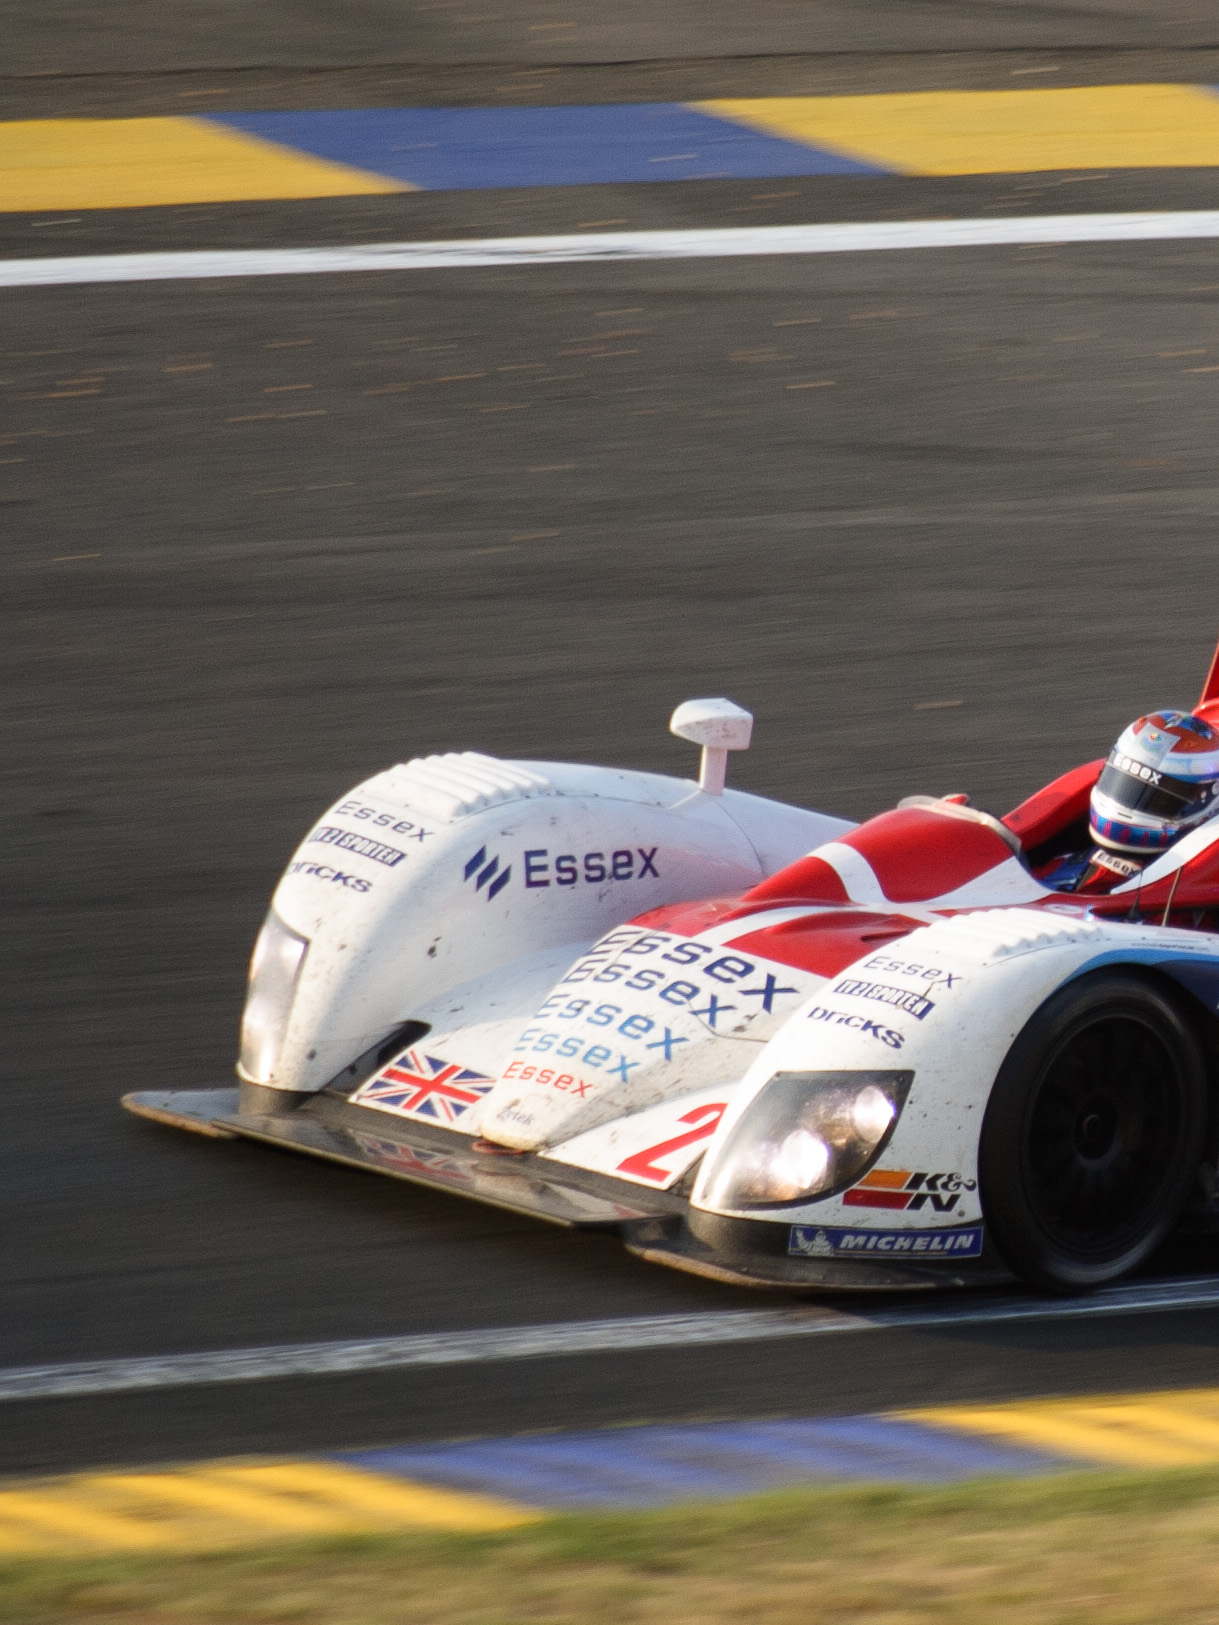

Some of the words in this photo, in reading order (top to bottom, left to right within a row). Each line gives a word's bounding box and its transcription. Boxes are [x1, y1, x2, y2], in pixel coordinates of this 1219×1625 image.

[1113, 753, 1162, 786] Essex
[335, 800, 435, 842] Essex
[524, 847, 660, 889] Essex
[560, 958, 737, 1028] Essex
[581, 930, 800, 1014] Essex
[863, 955, 963, 989] Essex
[867, 984, 930, 1017] SPORTEN
[533, 993, 690, 1062] Essex
[807, 1006, 906, 1050] bricks
[513, 1028, 642, 1083] Essex
[502, 1060, 595, 1098] Essex
[615, 1102, 729, 1183] 2
[839, 1233, 976, 1251] MICHELIN
